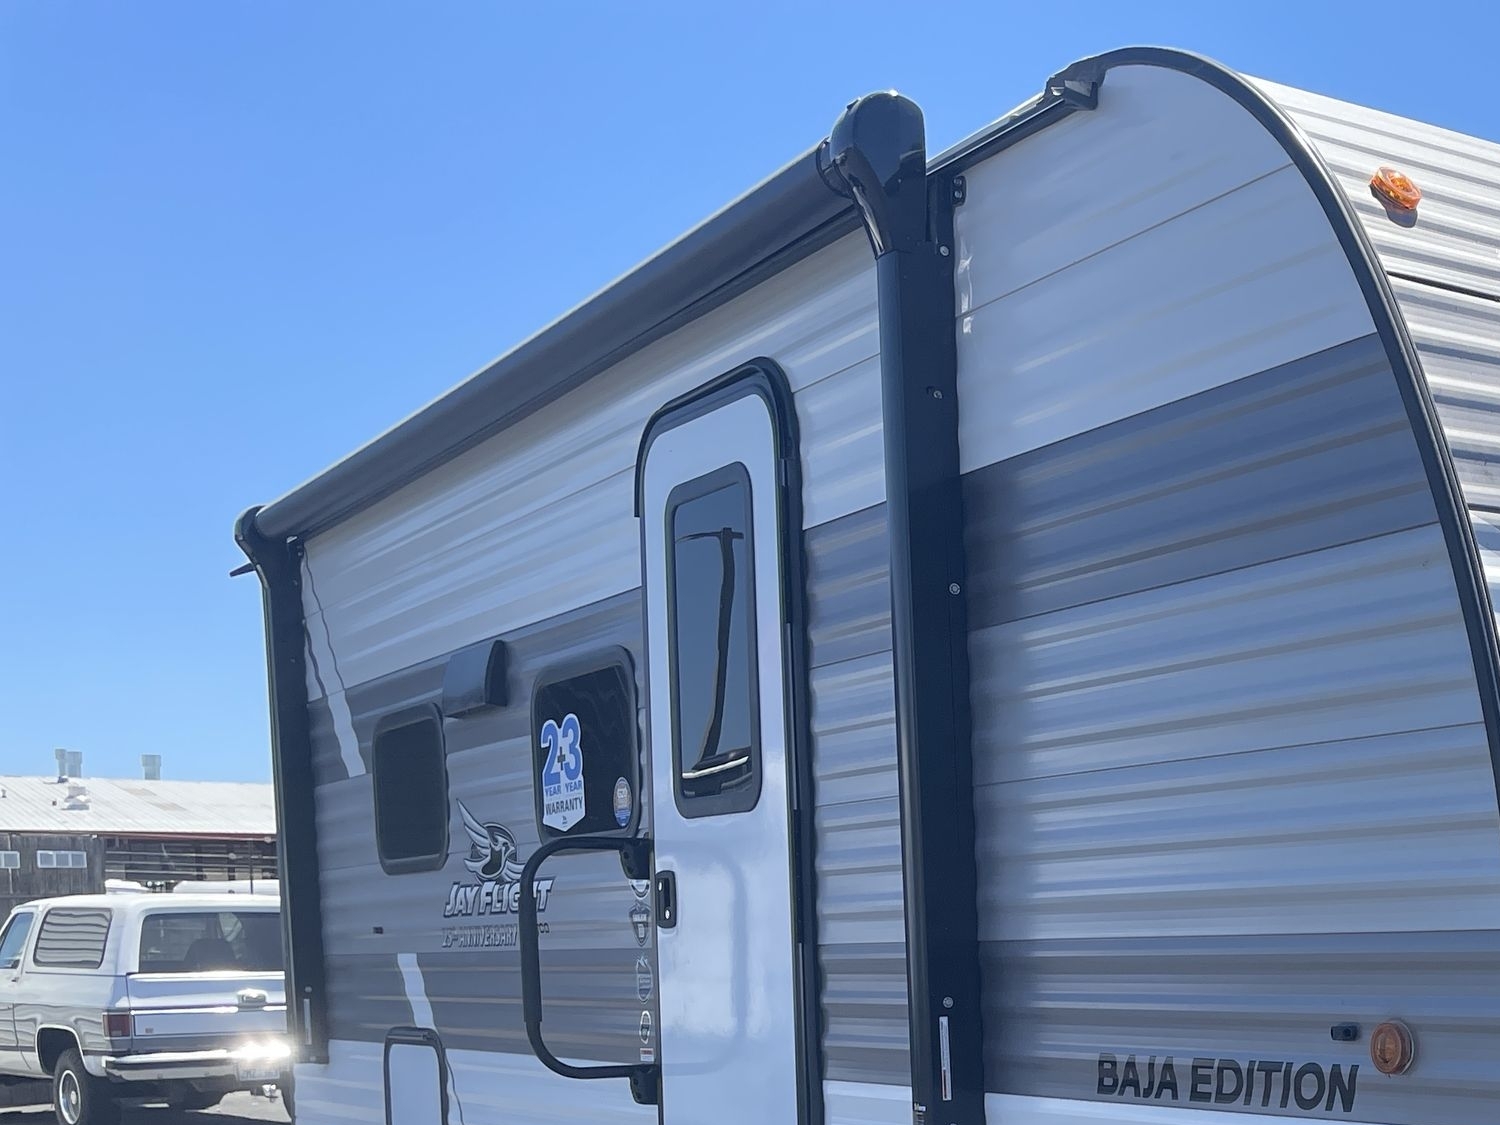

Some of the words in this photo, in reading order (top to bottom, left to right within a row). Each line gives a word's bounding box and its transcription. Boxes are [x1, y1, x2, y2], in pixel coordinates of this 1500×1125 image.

[545, 785, 561, 798] YEAR
[565, 780, 583, 793] YEAR
[545, 797, 584, 816] WARRANTY
[443, 881, 479, 918] JAY
[478, 877, 556, 915] FLIGT
[459, 923, 518, 947] ANNIVERSARY
[1097, 1053, 1179, 1101] BAJA
[1189, 1057, 1360, 1113] EDITION
